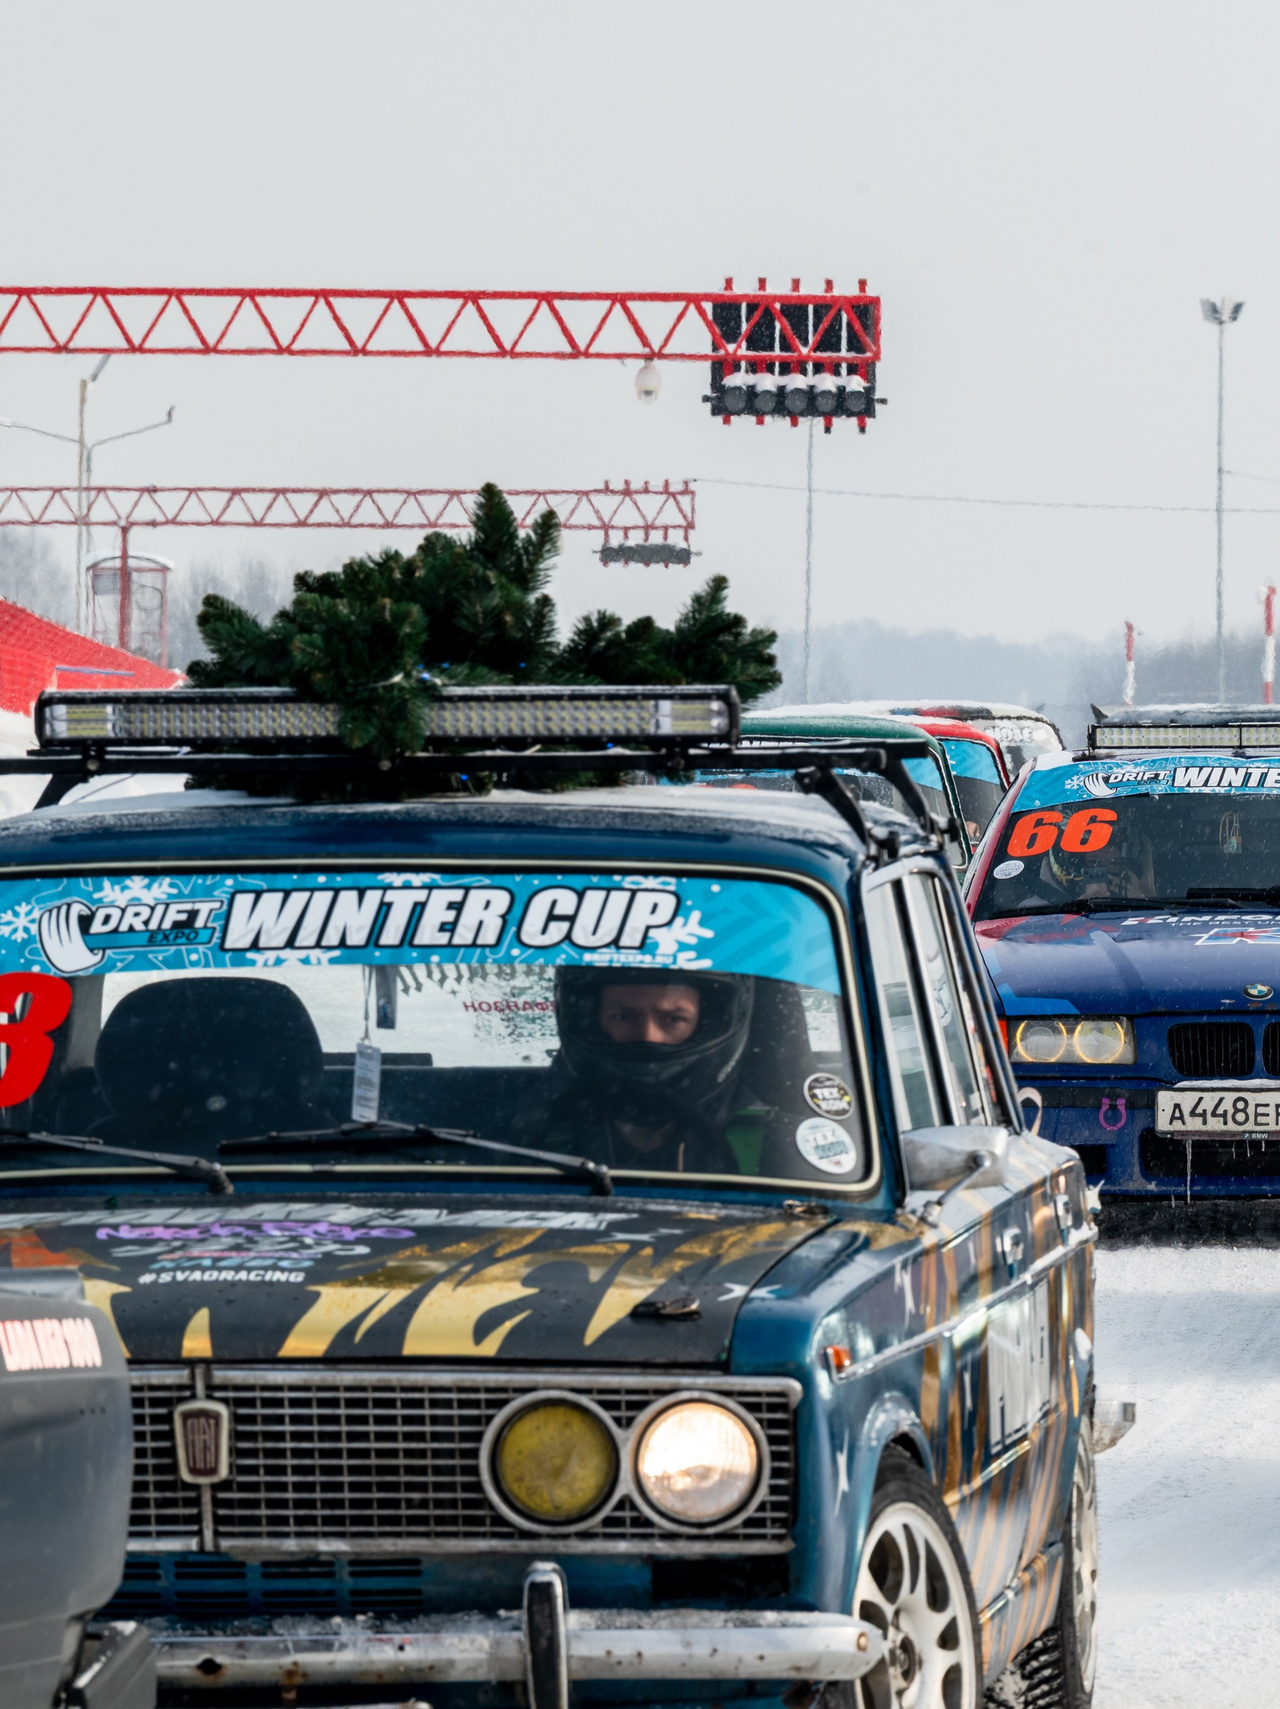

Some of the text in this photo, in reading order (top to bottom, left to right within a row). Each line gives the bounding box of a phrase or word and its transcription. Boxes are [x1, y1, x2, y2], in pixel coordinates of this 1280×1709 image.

[1108, 770, 1171, 783] DRIFT
[1006, 808, 1118, 858] 66
[89, 886, 681, 950] DRIFT WINTER CUP
[147, 929, 199, 944] EXPO
